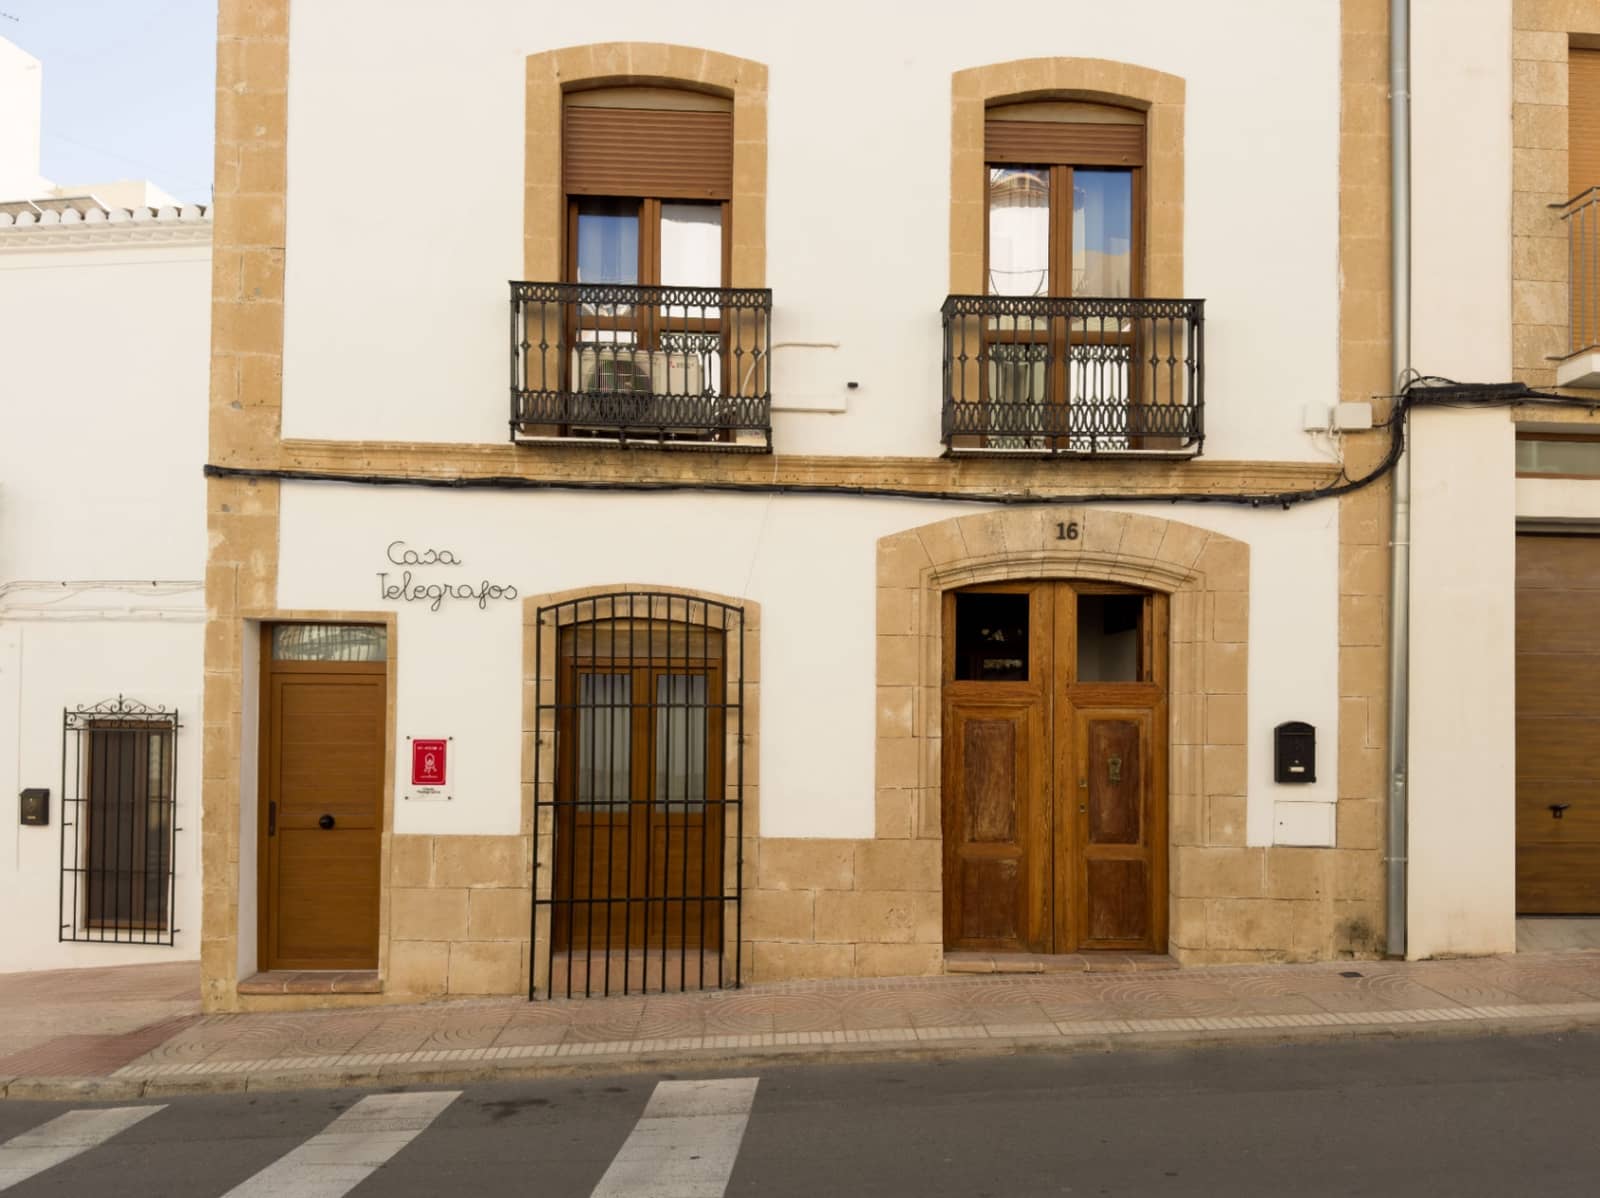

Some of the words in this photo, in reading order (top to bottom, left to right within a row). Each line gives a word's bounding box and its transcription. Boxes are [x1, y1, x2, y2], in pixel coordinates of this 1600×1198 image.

[1055, 521, 1079, 541] 16
[387, 540, 462, 565] Casa
[375, 570, 518, 612] Telegrafos
